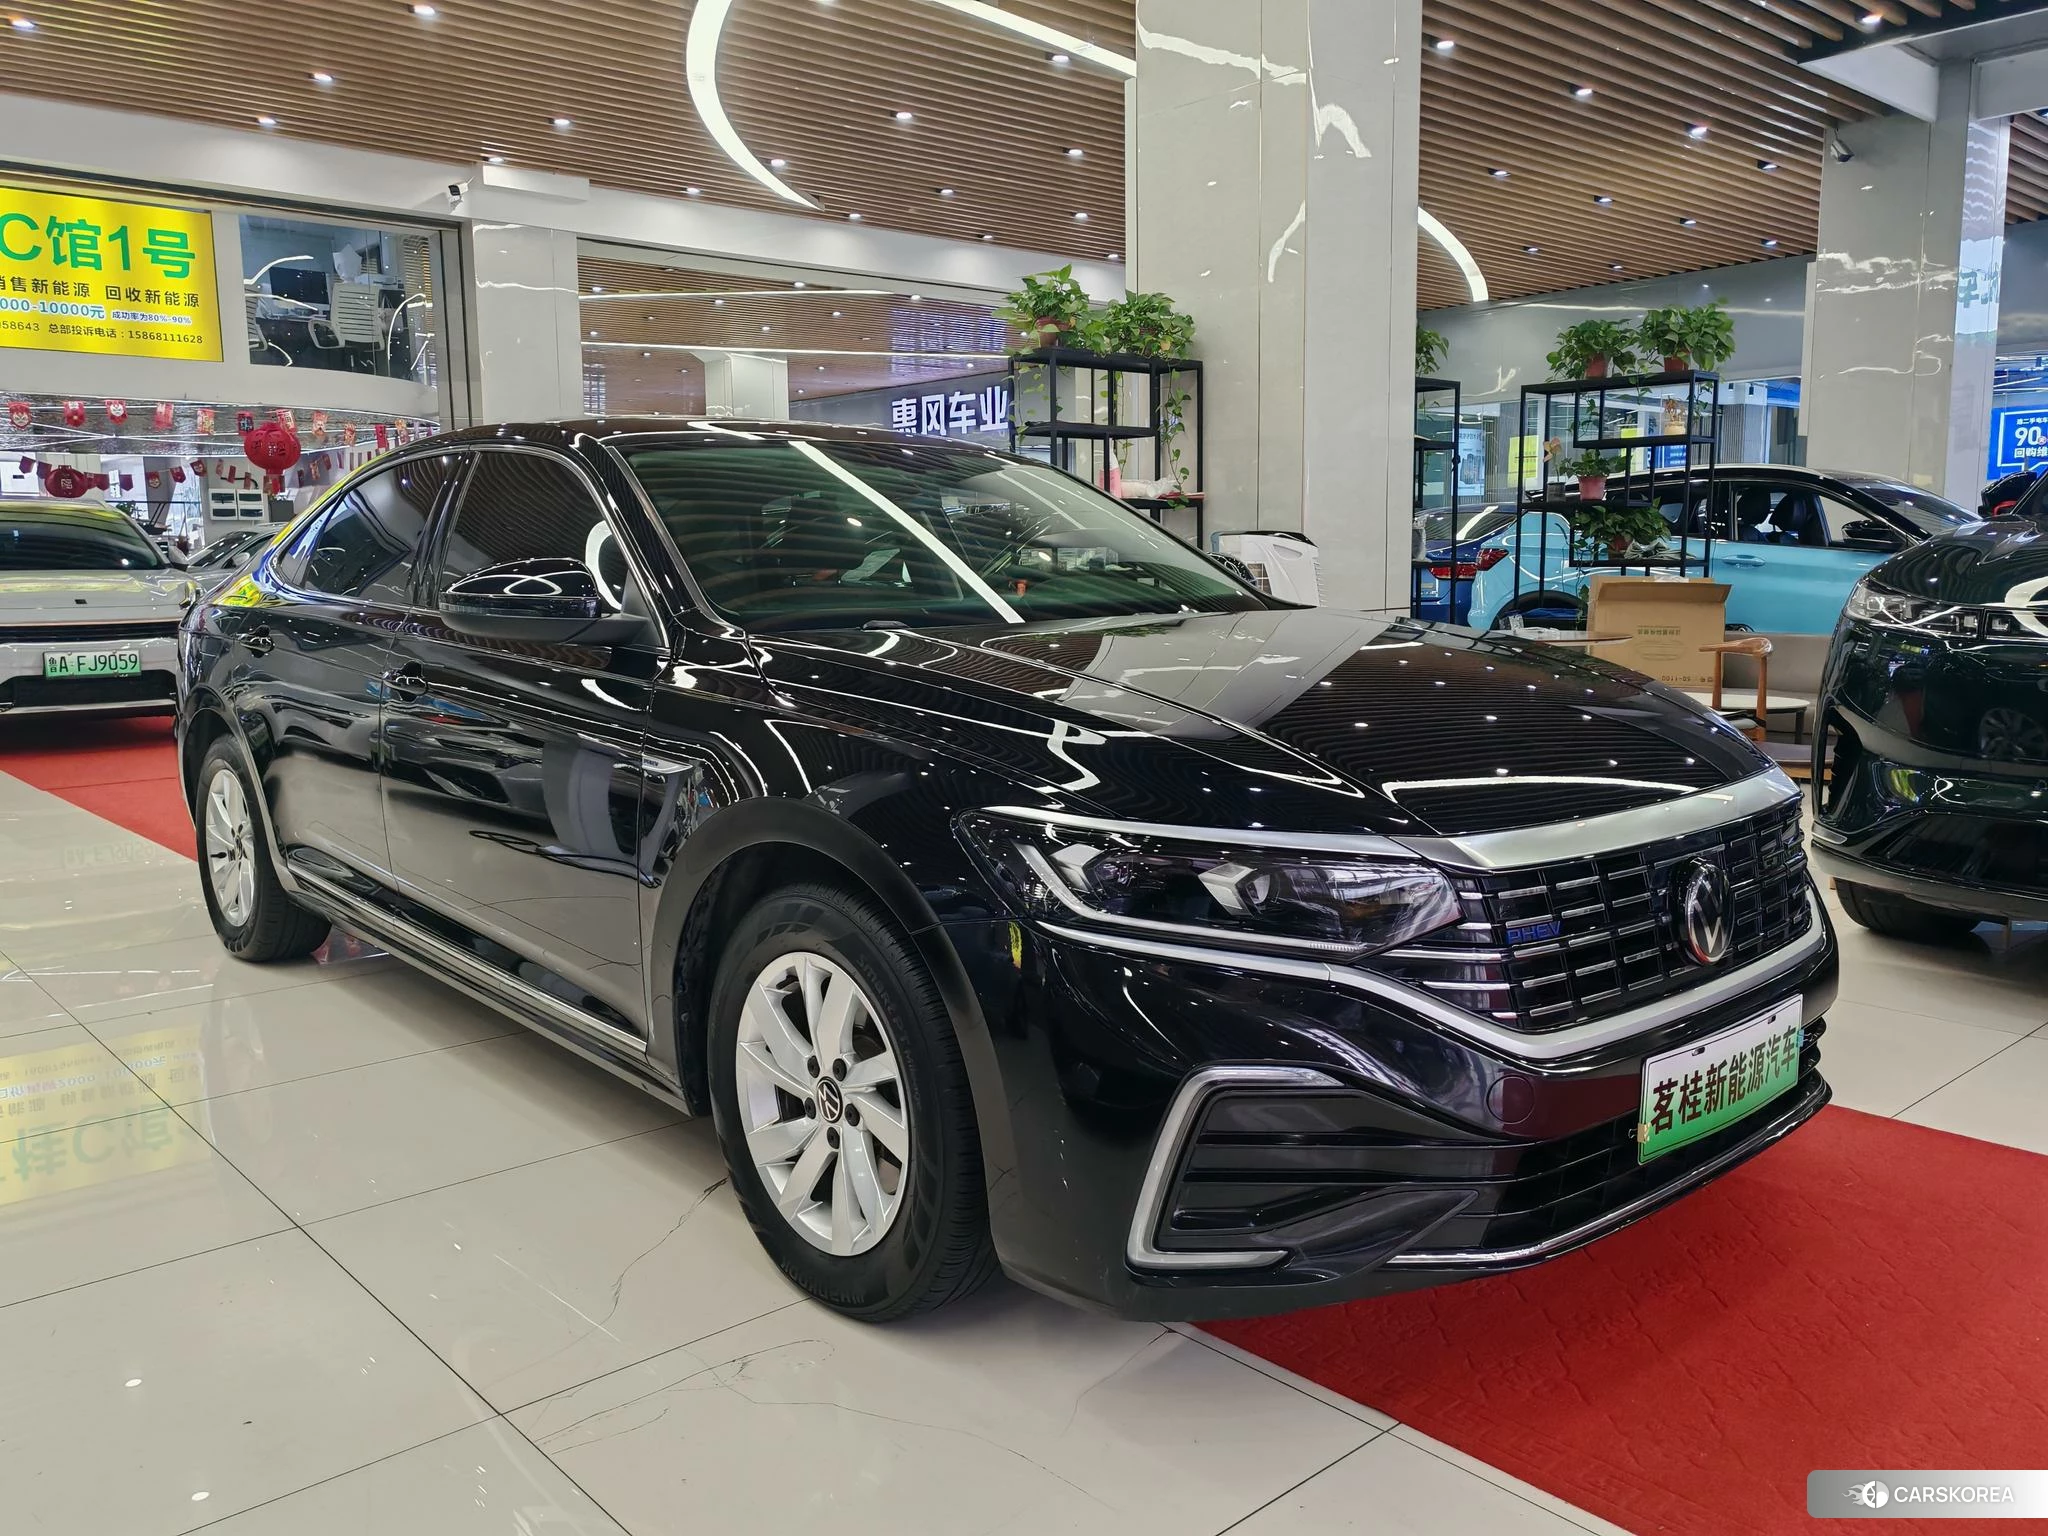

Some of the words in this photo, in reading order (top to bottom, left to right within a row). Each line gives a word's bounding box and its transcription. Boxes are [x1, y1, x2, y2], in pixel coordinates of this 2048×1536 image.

[0, 213, 196, 280] C馆1号
[105, 285, 200, 308] 回收新能源
[0, 320, 41, 332] 58643
[891, 386, 1009, 436] 惠风车业
[77, 653, 138, 672] FJ9059
[1507, 920, 1561, 945] PHEV
[1650, 1025, 1797, 1135] 茗桂新能源汽车
